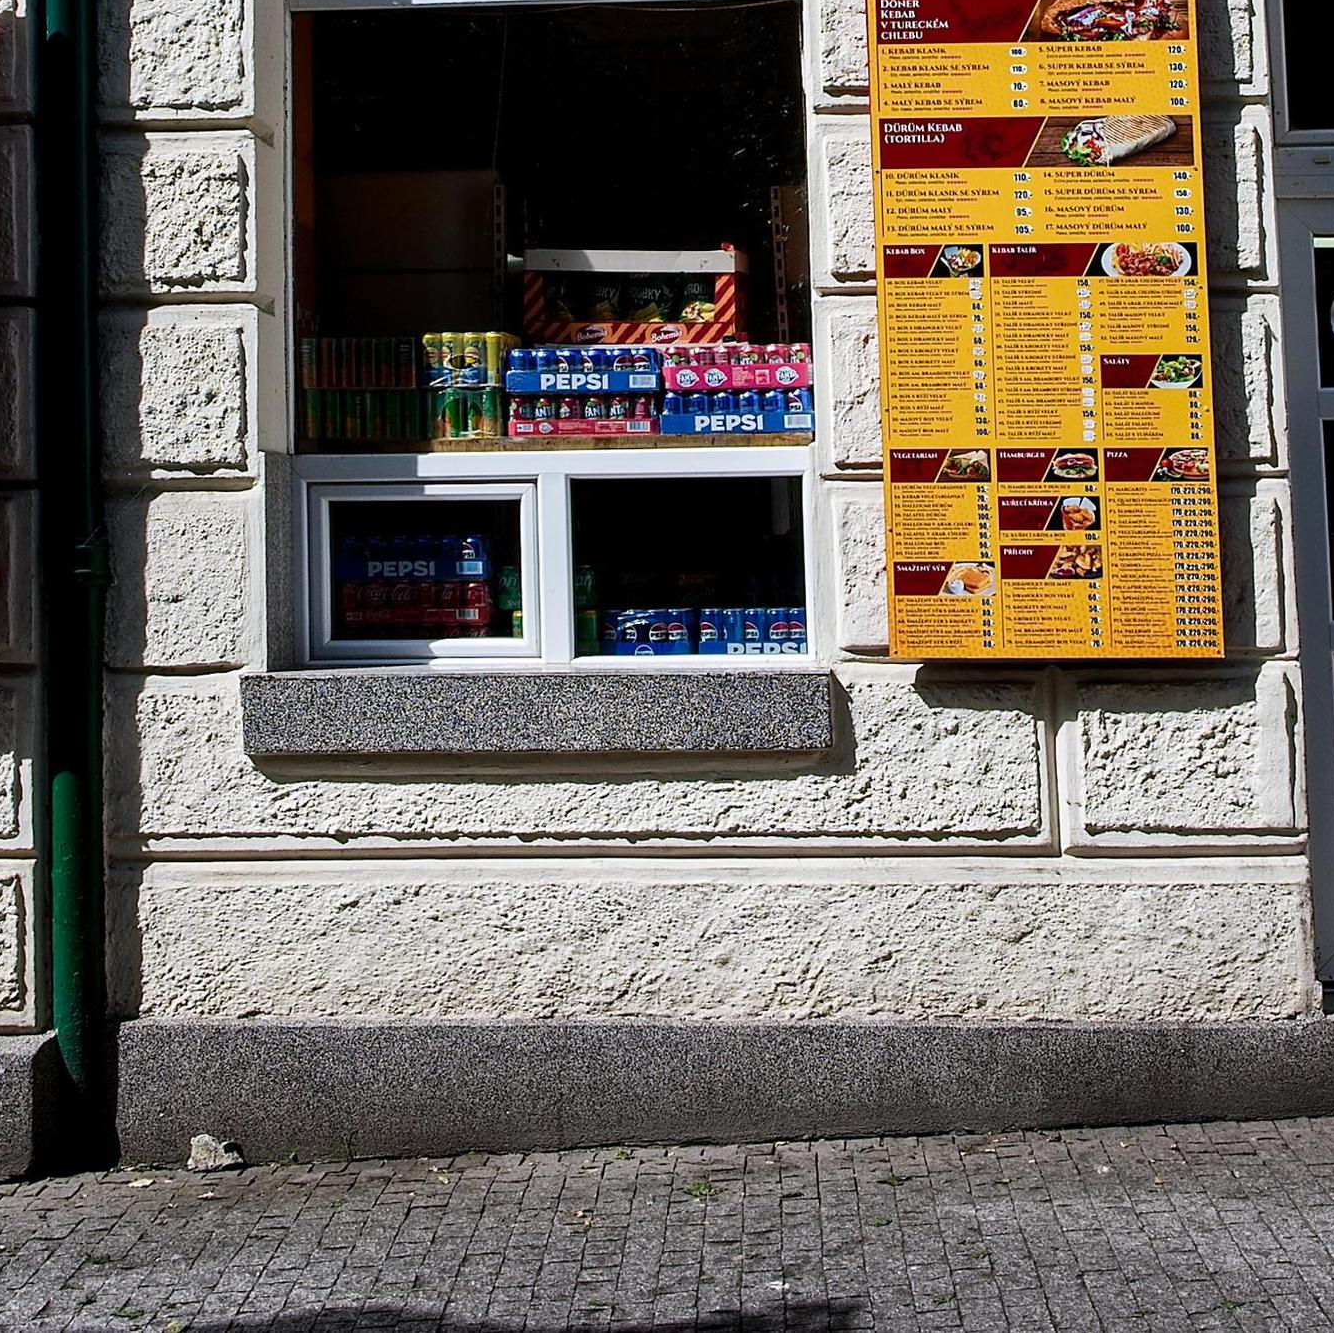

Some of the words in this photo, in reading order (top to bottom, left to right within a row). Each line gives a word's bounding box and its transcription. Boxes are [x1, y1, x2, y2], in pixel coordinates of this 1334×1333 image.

[880, 0, 919, 8] DÖNER
[881, 10, 915, 19] KEBAB
[881, 31, 923, 40] CHLEBU
[884, 122, 925, 132] DÜRÜM
[927, 122, 963, 132] KEBAB
[884, 133, 945, 144] (TORTILLA)
[540, 373, 609, 390] PEPSI
[694, 414, 764, 432] PEPSI
[367, 560, 436, 577] PEPSI
[727, 642, 806, 654] PEPSI
